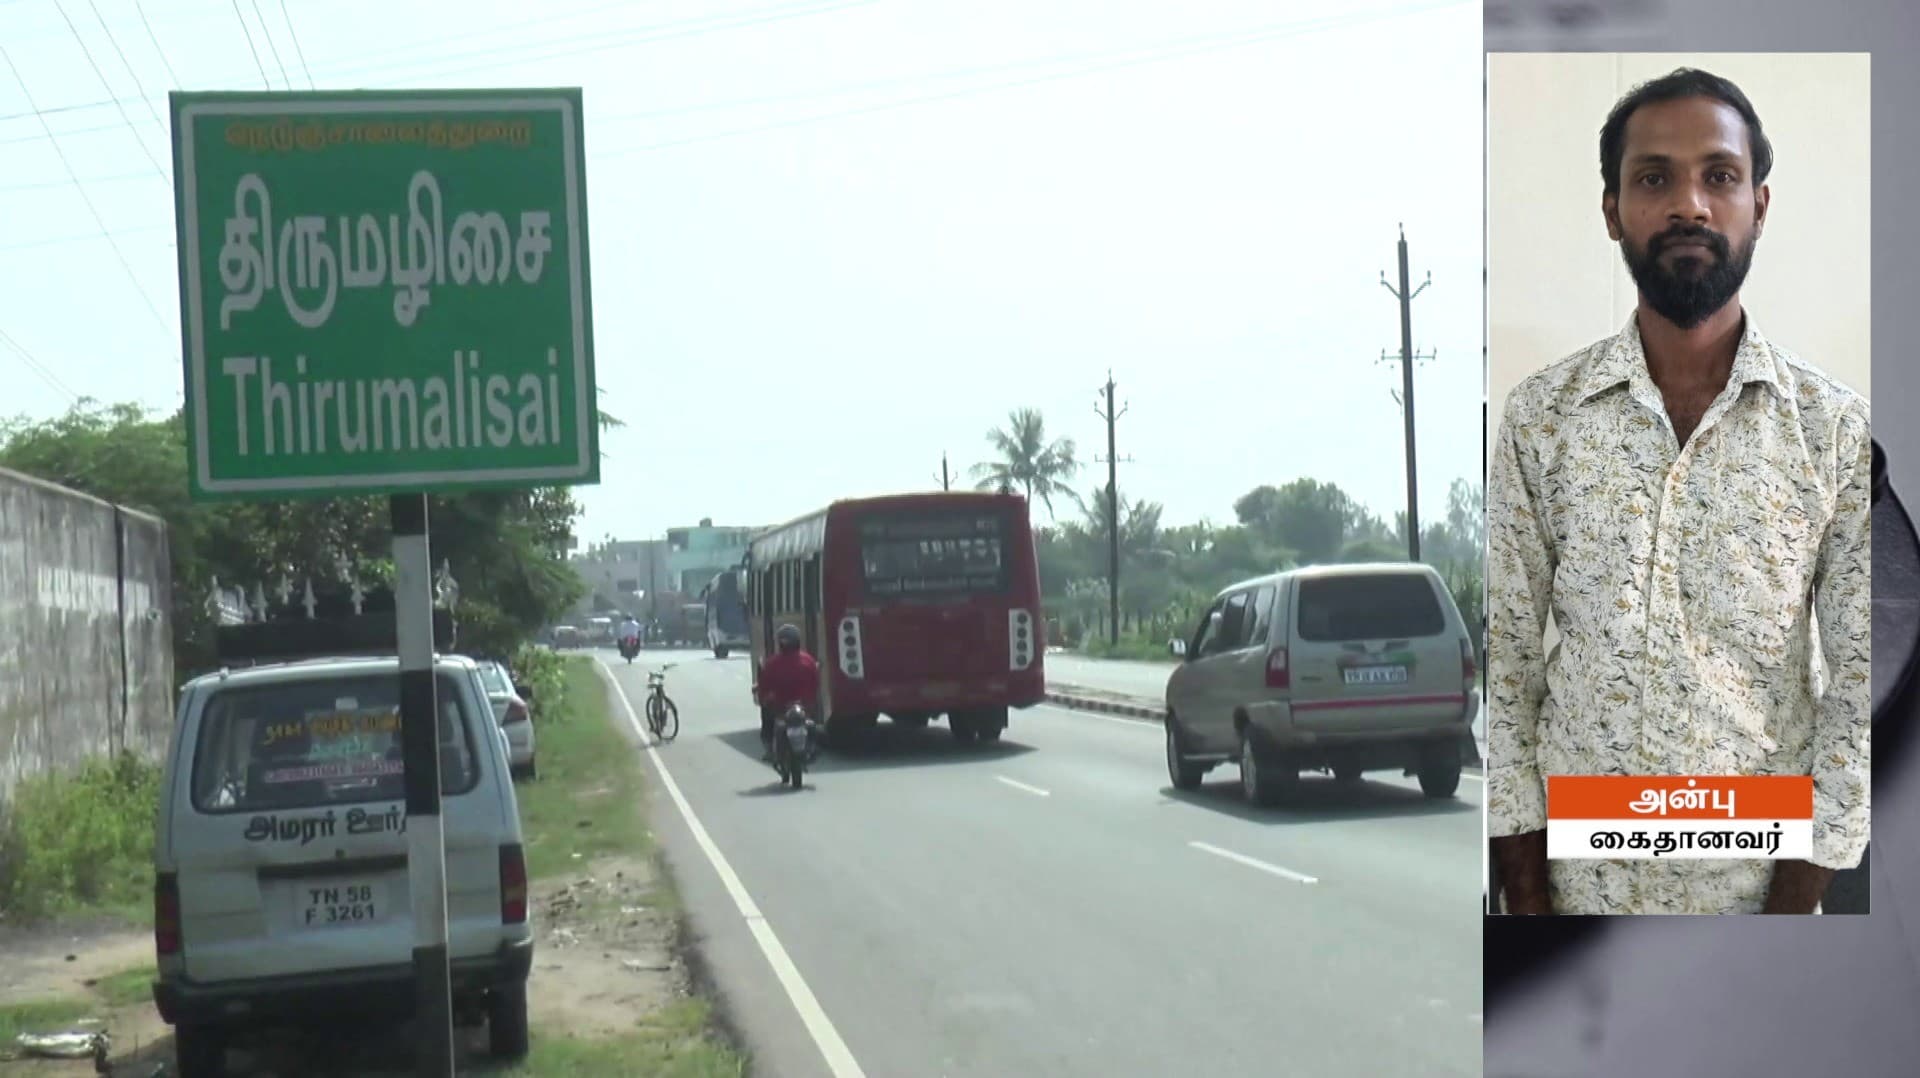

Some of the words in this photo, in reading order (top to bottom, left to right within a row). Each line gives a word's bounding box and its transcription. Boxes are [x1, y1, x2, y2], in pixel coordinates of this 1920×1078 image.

[219, 170, 552, 330] திருமழிசை
[223, 347, 561, 455] Thirumalisai
[244, 810, 337, 845] அமரர்
[309, 887, 339, 905] TN
[305, 907, 318, 925] F
[325, 903, 375, 922] 3261
